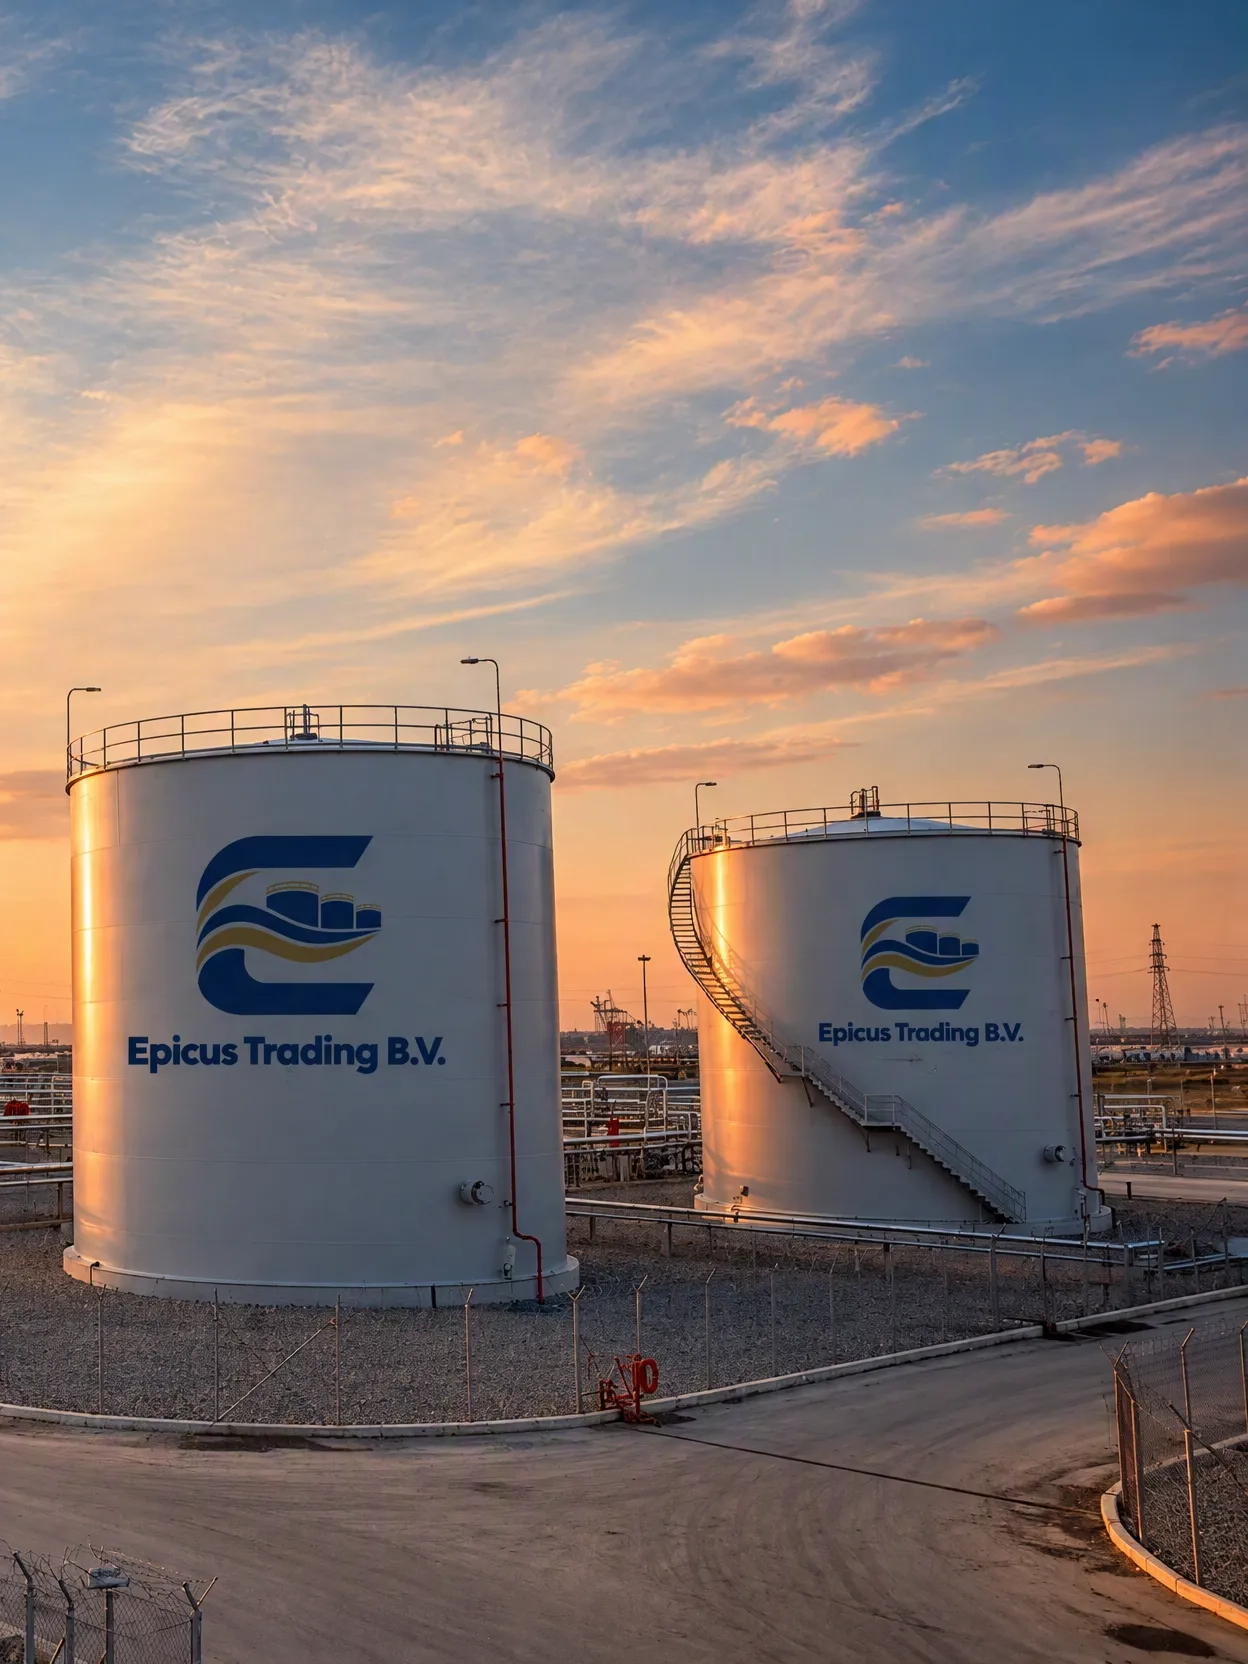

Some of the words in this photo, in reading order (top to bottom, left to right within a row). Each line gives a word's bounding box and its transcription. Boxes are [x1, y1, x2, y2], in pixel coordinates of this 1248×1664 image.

[818, 1021, 892, 1047] Epicus
[894, 1021, 980, 1048] Trading
[985, 1022, 1025, 1042] B.V.
[128, 1034, 239, 1074] Epicus
[243, 1034, 379, 1075] Trading
[388, 1036, 447, 1066] B.V.
